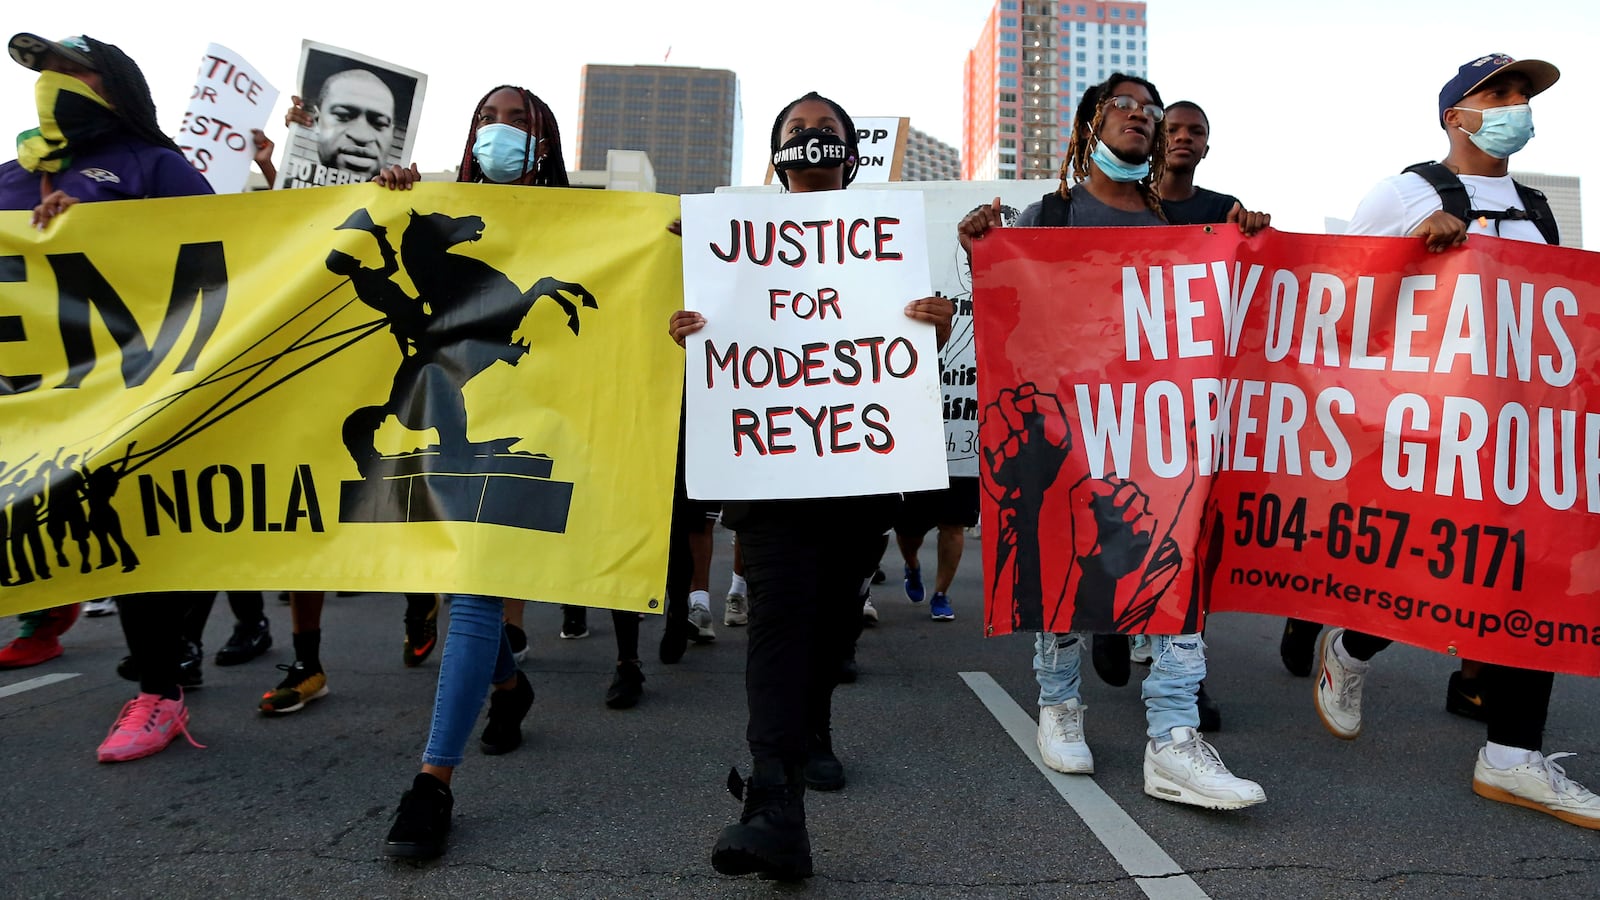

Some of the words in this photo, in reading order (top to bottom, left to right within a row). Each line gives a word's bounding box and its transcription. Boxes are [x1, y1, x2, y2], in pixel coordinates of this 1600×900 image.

[774, 146, 804, 164] GIMME
[806, 138, 821, 163] 6
[823, 144, 845, 159] FEET
[709, 216, 903, 268] JUSTICE
[769, 288, 842, 320] FOR
[1122, 260, 1264, 361] NEW
[1264, 269, 1578, 388] ORLEANS
[705, 337, 918, 389] MODESTO
[732, 403, 895, 457] REYES
[1074, 377, 1356, 481] WORKERS
[138, 463, 324, 537] NOLA
[1234, 492, 1525, 591] 504-657-3171
